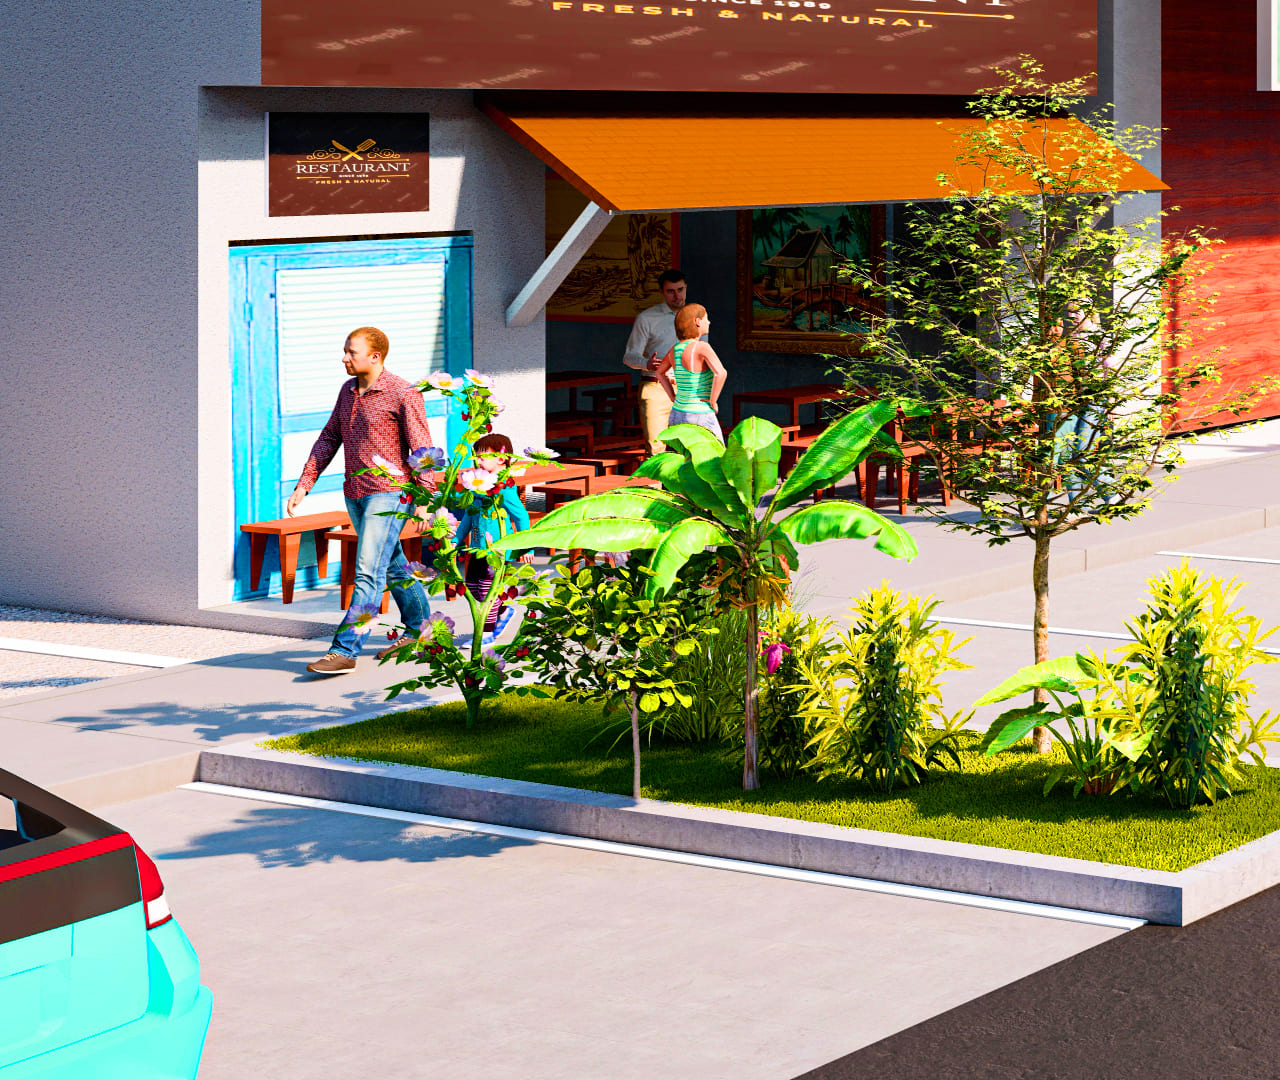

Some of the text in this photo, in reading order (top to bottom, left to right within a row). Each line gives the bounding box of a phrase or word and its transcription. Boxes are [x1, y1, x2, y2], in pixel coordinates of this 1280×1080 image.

[774, 0, 832, 10] 1989
[552, 2, 934, 29] FRESH & NATURAL
[296, 162, 411, 174] RESTAURANT
